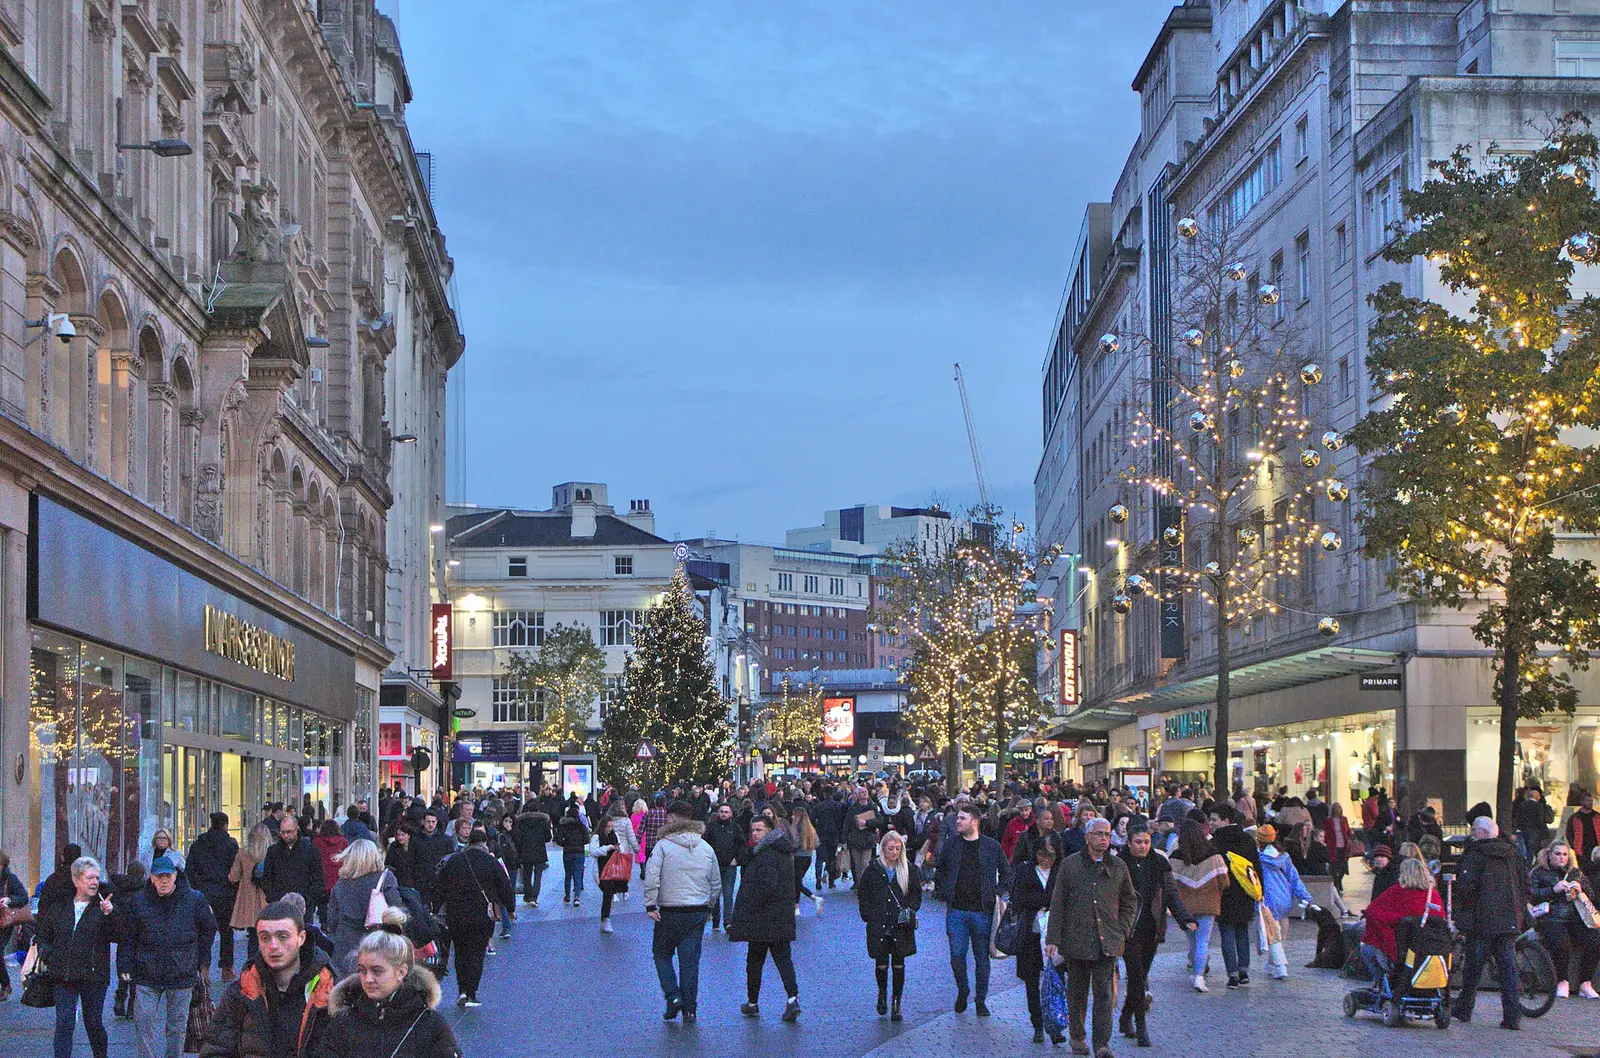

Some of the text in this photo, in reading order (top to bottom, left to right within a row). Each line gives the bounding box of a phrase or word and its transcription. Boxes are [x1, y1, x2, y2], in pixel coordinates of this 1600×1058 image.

[1064, 632, 1075, 701] COTSWOLD
[826, 716, 851, 724] SALE
[1164, 708, 1209, 741] PRIMARK
